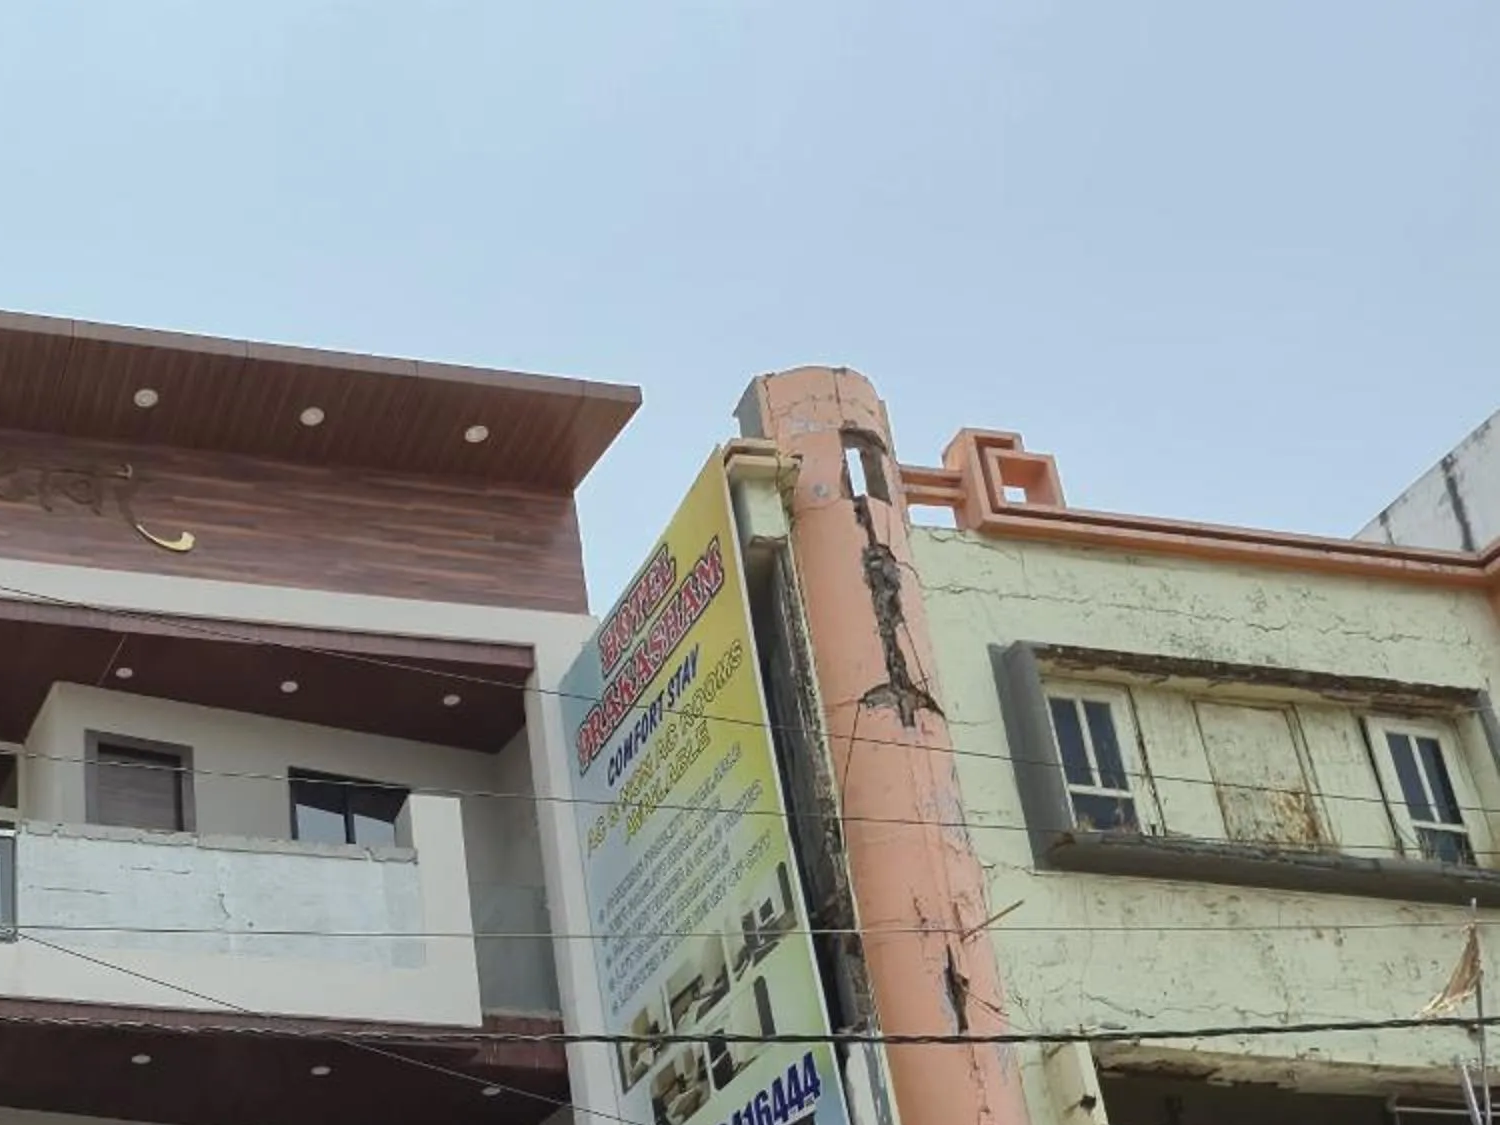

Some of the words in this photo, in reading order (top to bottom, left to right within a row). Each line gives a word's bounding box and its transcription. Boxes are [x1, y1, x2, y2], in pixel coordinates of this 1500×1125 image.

[577, 536, 724, 775] PRAKASHAM
[599, 544, 676, 678] HOTEL
[608, 691, 664, 786] COMFORT
[667, 643, 699, 708] STAY
